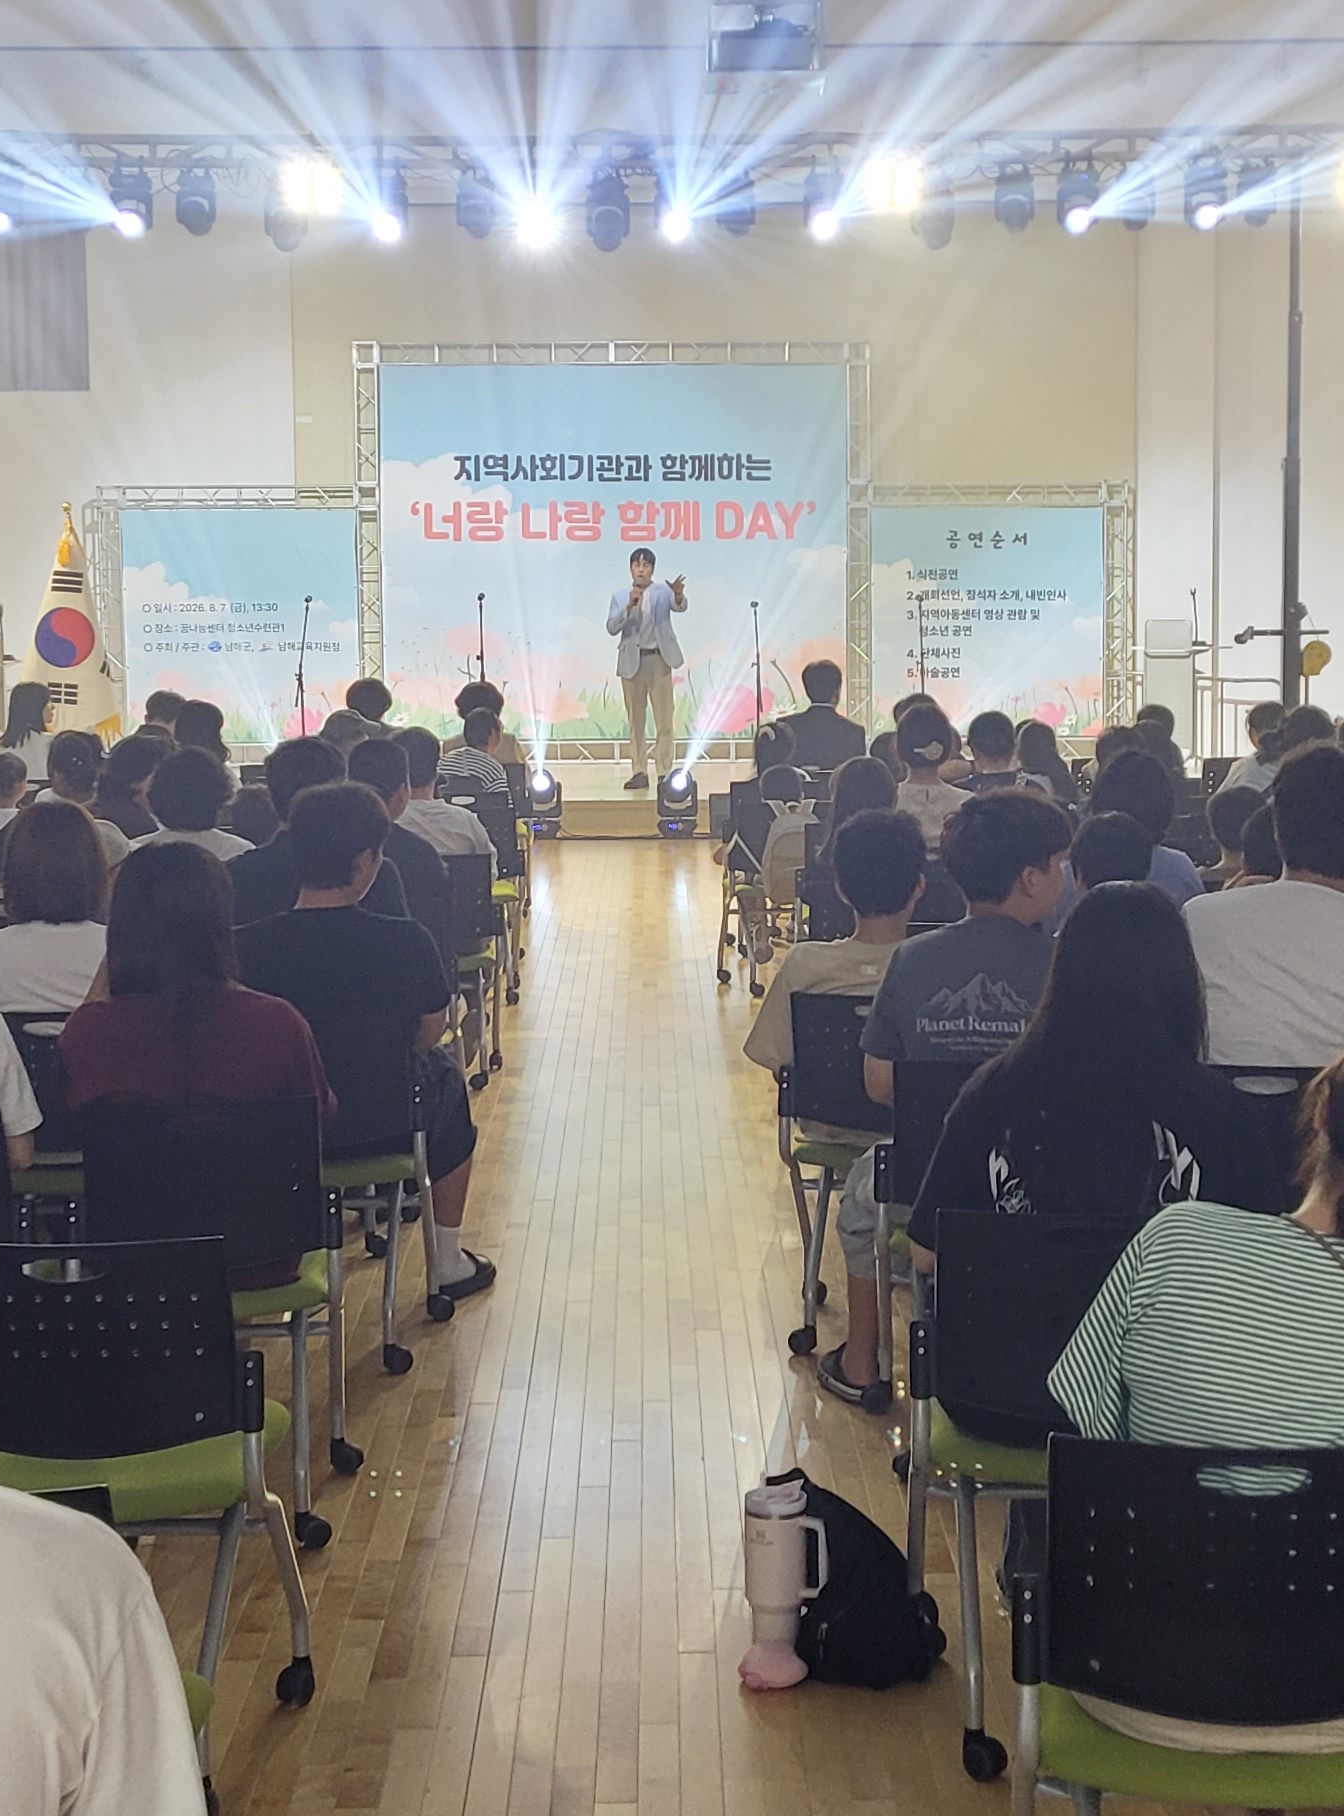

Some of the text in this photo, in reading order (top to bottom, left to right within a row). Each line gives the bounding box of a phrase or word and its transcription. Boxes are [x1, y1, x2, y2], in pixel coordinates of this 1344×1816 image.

[453, 453, 773, 482] 지역사회기관과 함께하는
[521, 500, 605, 542] 나랑
[617, 500, 700, 542] 함께
[906, 567, 959, 581] 1. 식전공연
[966, 588, 997, 601] 참석자
[999, 588, 1023, 602] 소개,
[1025, 588, 1067, 601] 내빈인사
[153, 602, 172, 614] 일시
[251, 602, 278, 612] 13:30
[906, 608, 1040, 621] 3. 지역아동센터 영상 관람 및
[155, 623, 173, 634] 장소
[952, 624, 972, 637] 공연
[182, 641, 199, 653] 주관
[906, 648, 917, 659] 4.
[906, 667, 917, 678] 5.
